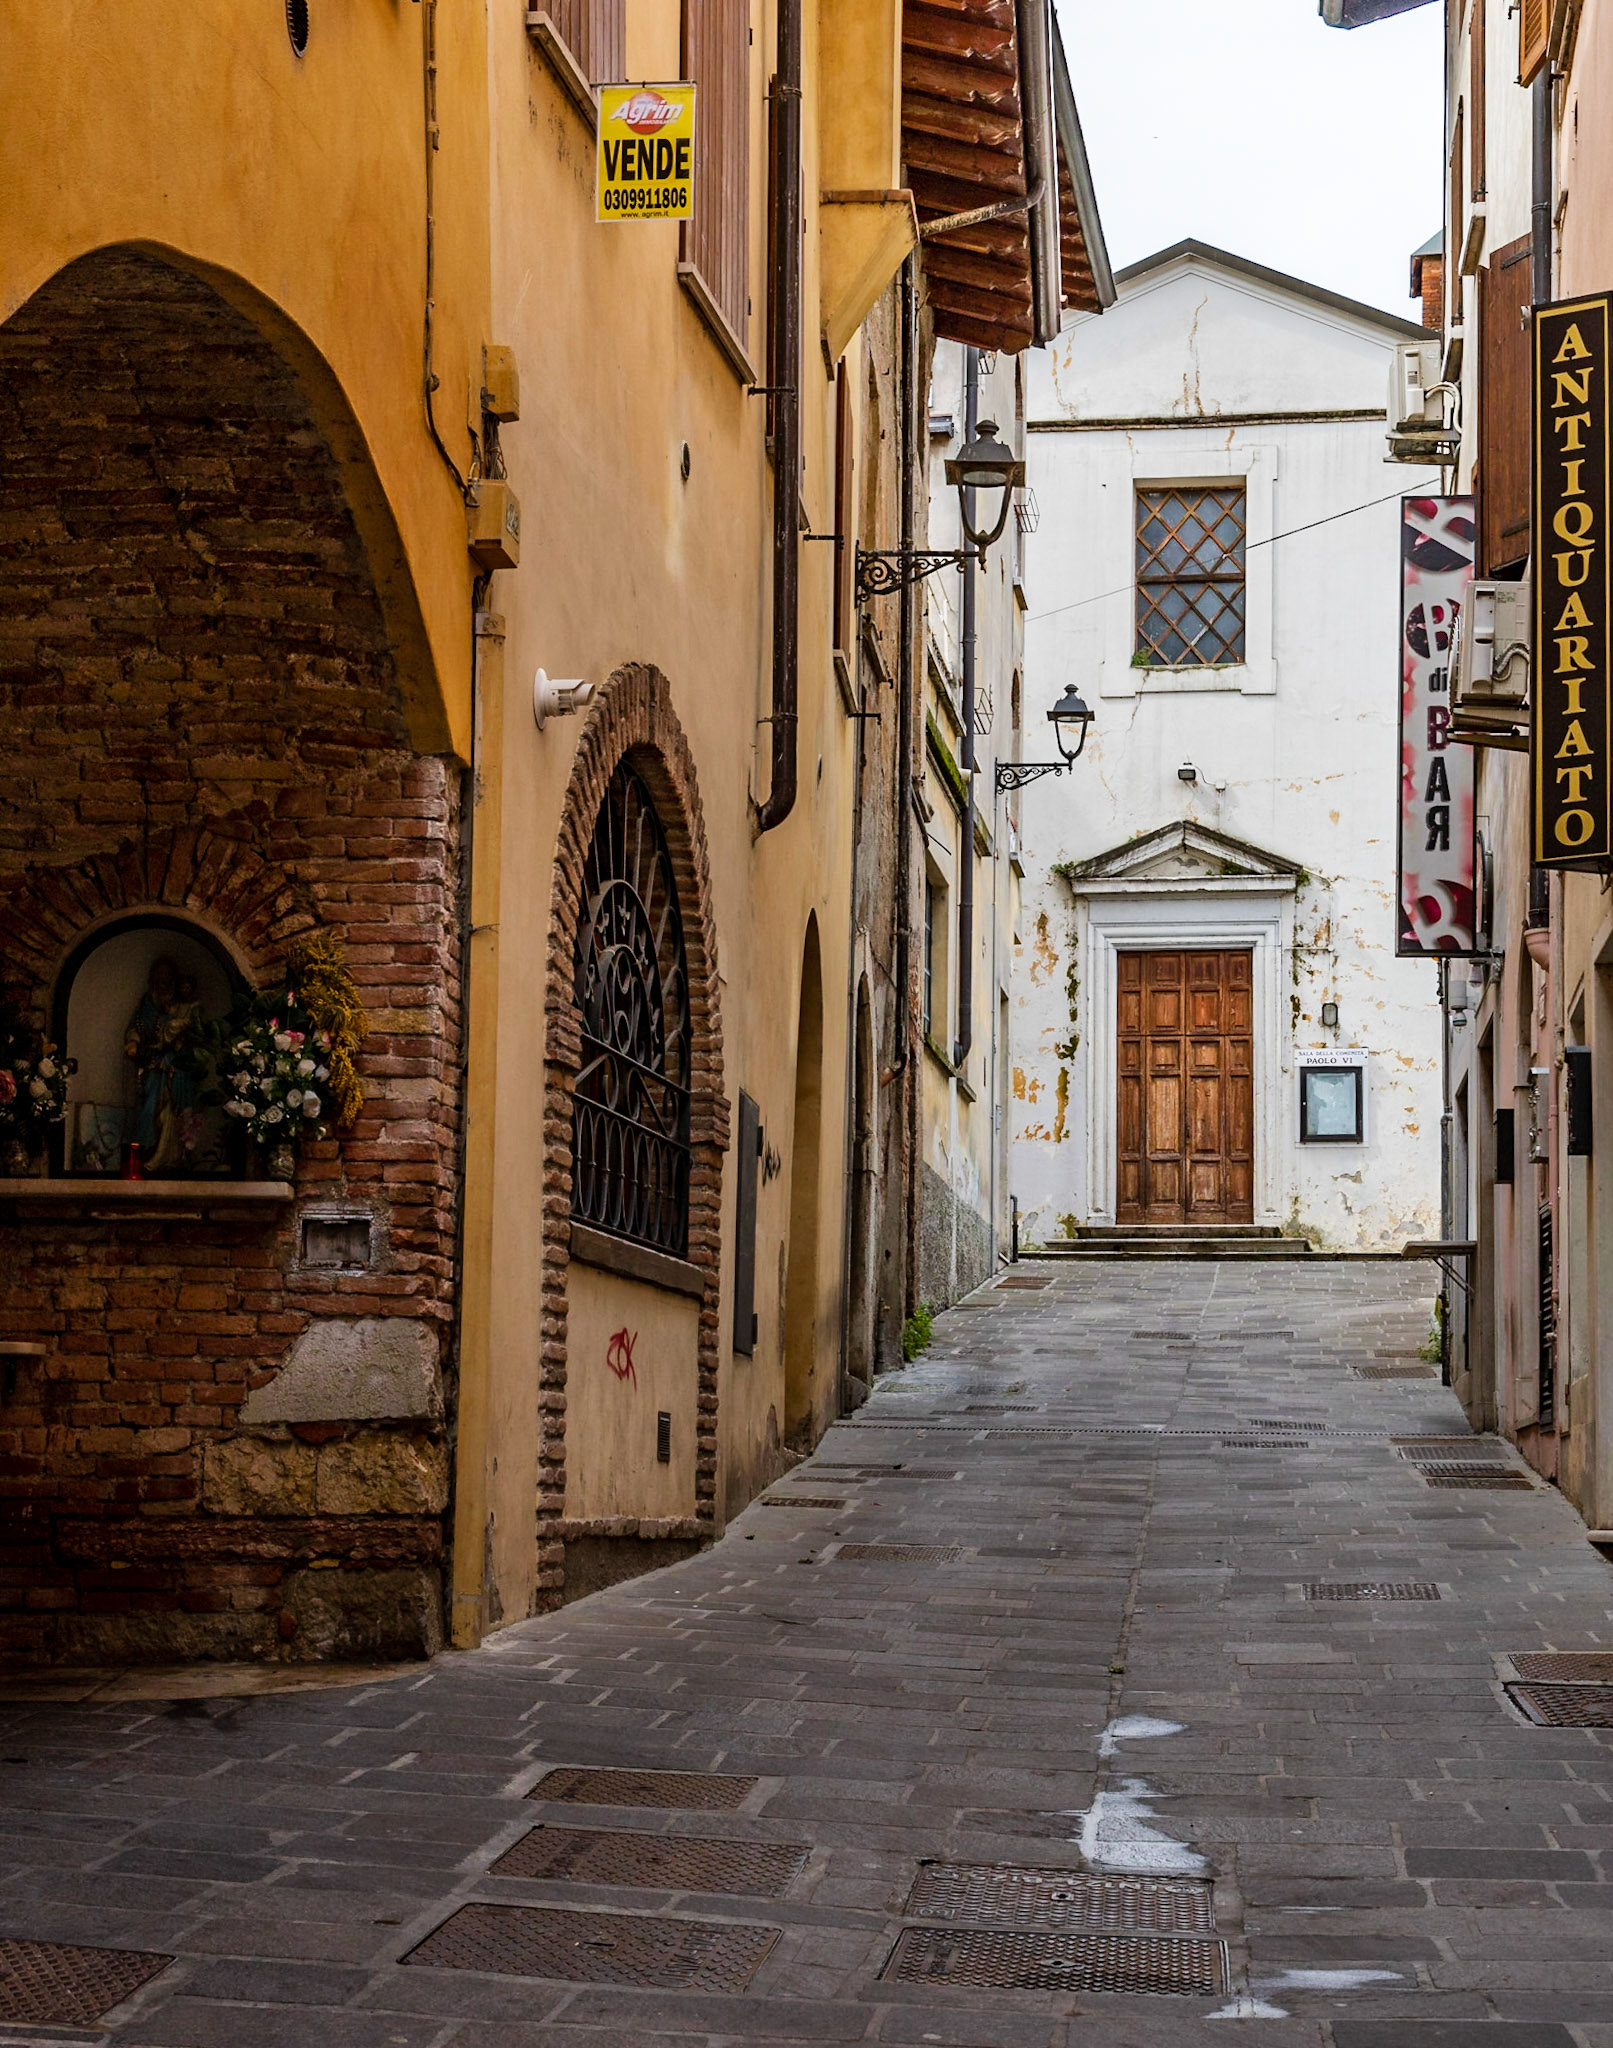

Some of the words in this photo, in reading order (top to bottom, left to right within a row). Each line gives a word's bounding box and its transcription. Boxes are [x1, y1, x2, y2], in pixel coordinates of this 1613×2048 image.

[610, 100, 684, 125] Agrim
[603, 138, 690, 181] VENDE
[604, 187, 687, 210] 0309911806
[1550, 322, 1596, 847] ANTIQUARIATO
[1428, 667, 1448, 692] di
